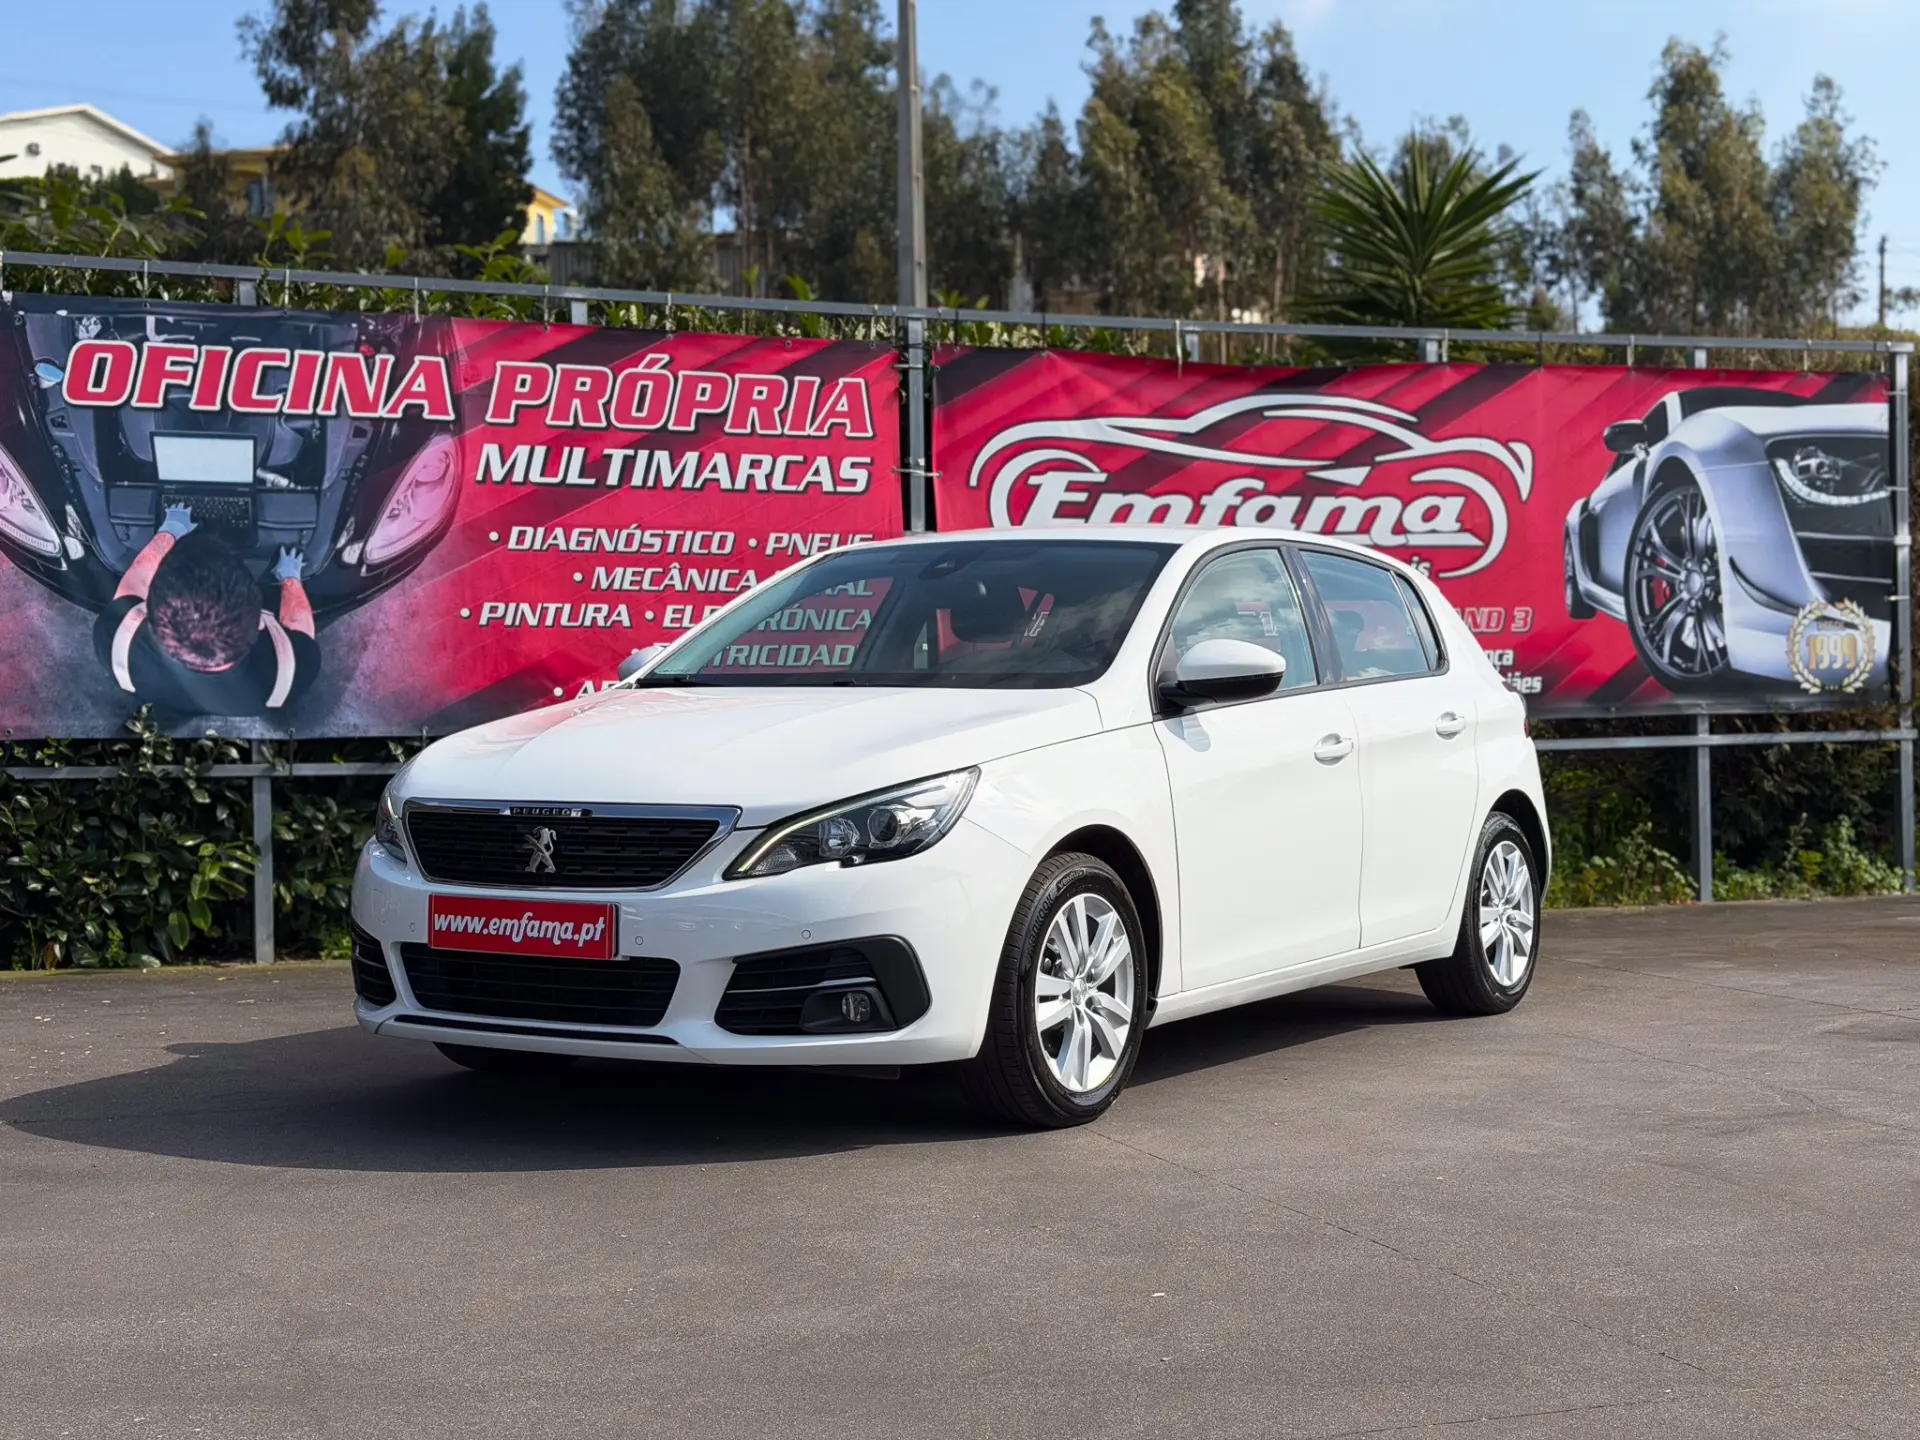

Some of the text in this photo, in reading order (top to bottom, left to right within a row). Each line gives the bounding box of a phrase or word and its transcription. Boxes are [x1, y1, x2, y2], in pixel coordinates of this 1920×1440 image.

[62, 340, 874, 438] OFICINA PRÓPRIA
[475, 443, 872, 493] MULTIMARCAS
[1022, 471, 1467, 547] Emfama
[507, 523, 735, 555] DIAGNÓSTICO
[590, 563, 758, 592] MECÂNICA
[478, 602, 631, 628] PINTURA
[1511, 607, 1532, 632] 3
[1806, 633, 1857, 670] 1999
[511, 806, 582, 818] PEUGEOT
[433, 911, 606, 948] www.emfama.pt
